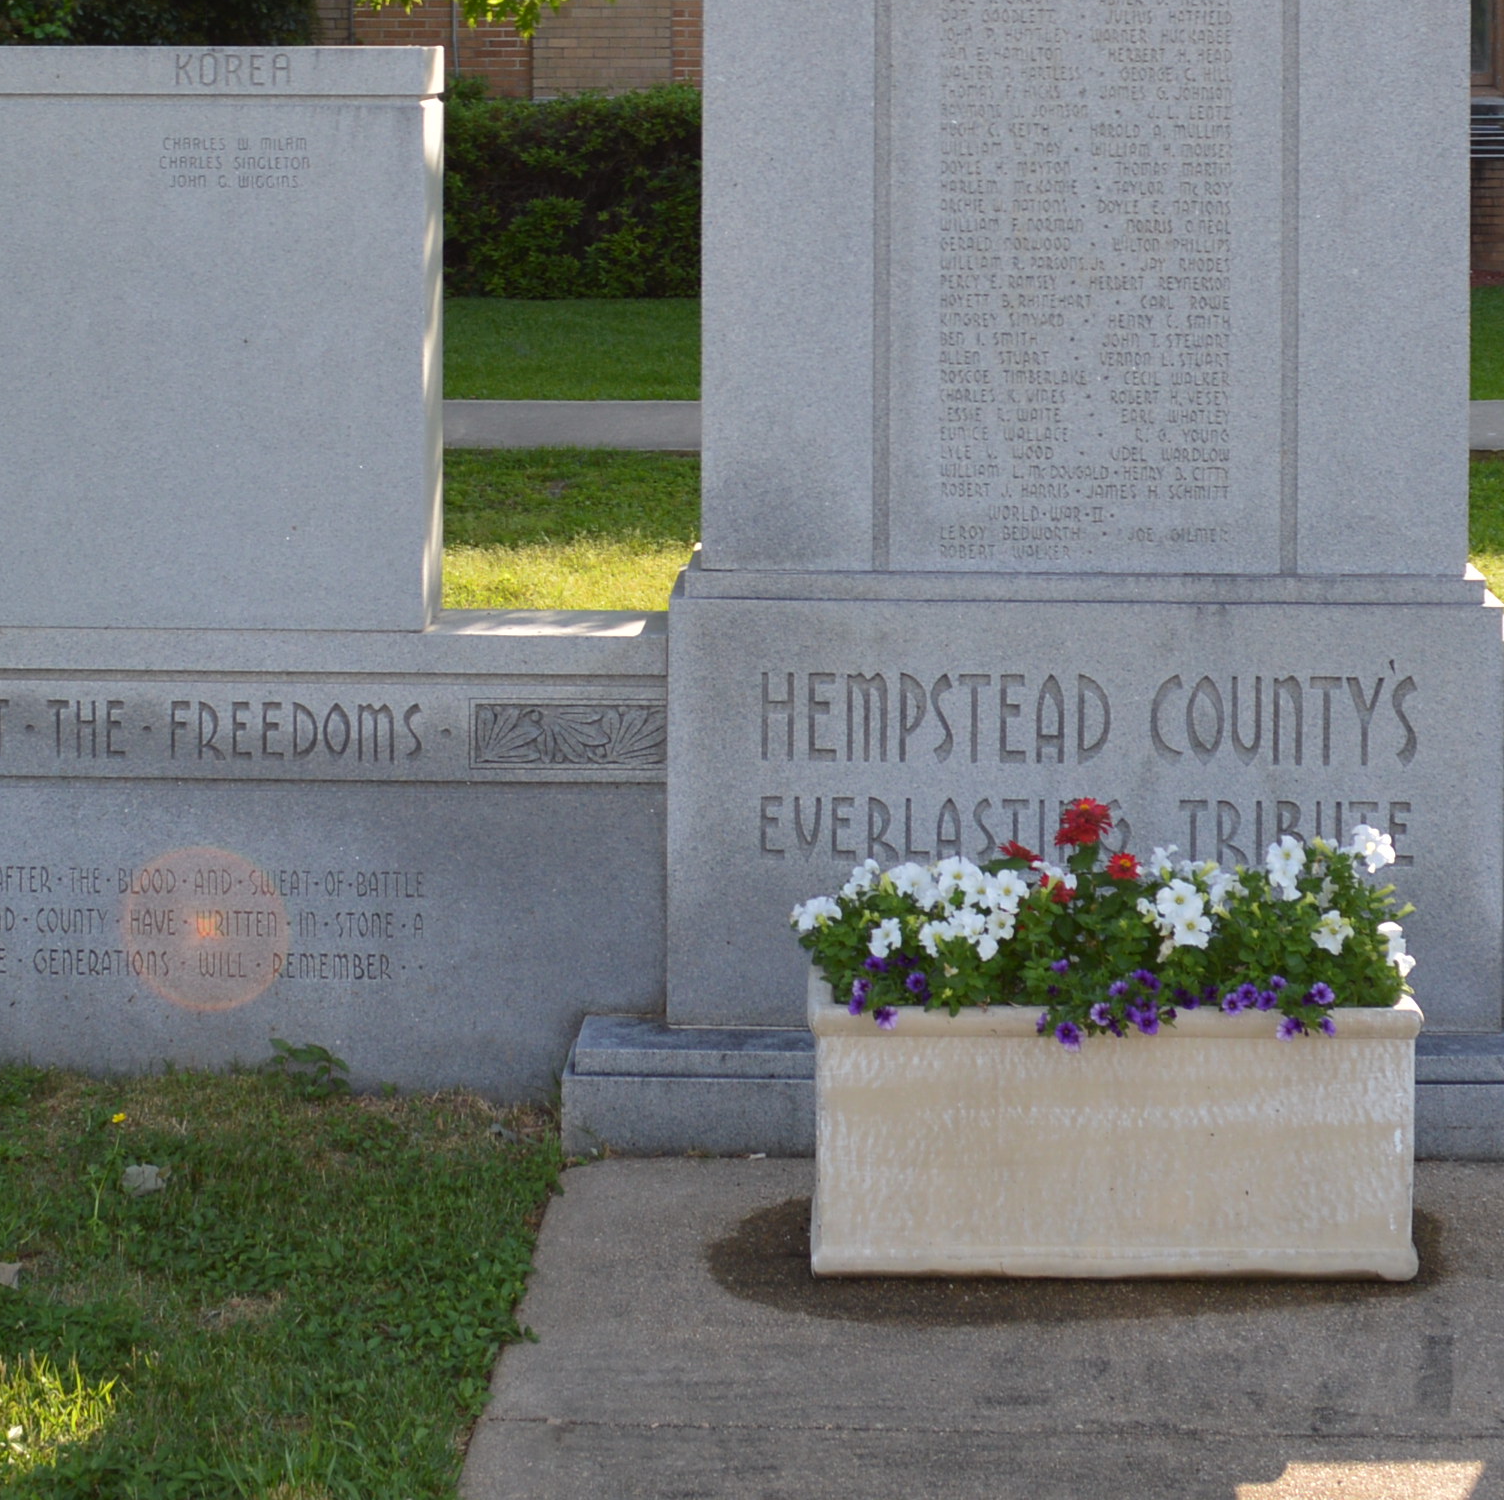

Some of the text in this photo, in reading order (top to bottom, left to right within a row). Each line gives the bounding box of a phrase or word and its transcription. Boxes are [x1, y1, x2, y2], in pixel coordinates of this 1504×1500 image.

[175, 53, 291, 86] KOREA
[163, 137, 226, 151] CHARLES
[261, 137, 307, 151] MILAM
[159, 156, 310, 170] CHARLES SINGLETON
[169, 175, 206, 188] JOHN
[238, 175, 298, 188] WIGGINS
[941, 483, 991, 498] ROBERT
[1021, 484, 1069, 499] HARRIS
[1086, 484, 1136, 499] JAMES
[1169, 485, 1229, 500] SCHMITT
[988, 506, 1104, 523] WORLD WAR II
[760, 658, 1418, 768] HEMPSTEAD COUNTY'S
[47, 699, 126, 759] THE
[170, 701, 423, 763] FREEDOMS
[69, 868, 101, 895] THE
[118, 868, 176, 895] BLOOD
[196, 869, 233, 895] AND
[250, 869, 311, 897] SWEAT
[324, 871, 346, 897] OF
[357, 871, 424, 898] BATTLE
[36, 907, 109, 934] COUNTY
[129, 909, 177, 937] HAVE
[196, 910, 278, 937] WRITTEN
[299, 912, 317, 937] IN
[335, 912, 394, 938] STONE
[413, 913, 424, 938] A
[33, 948, 170, 977] GENERATIONS
[198, 951, 247, 978] WILL
[272, 952, 392, 981] REMEMBER
